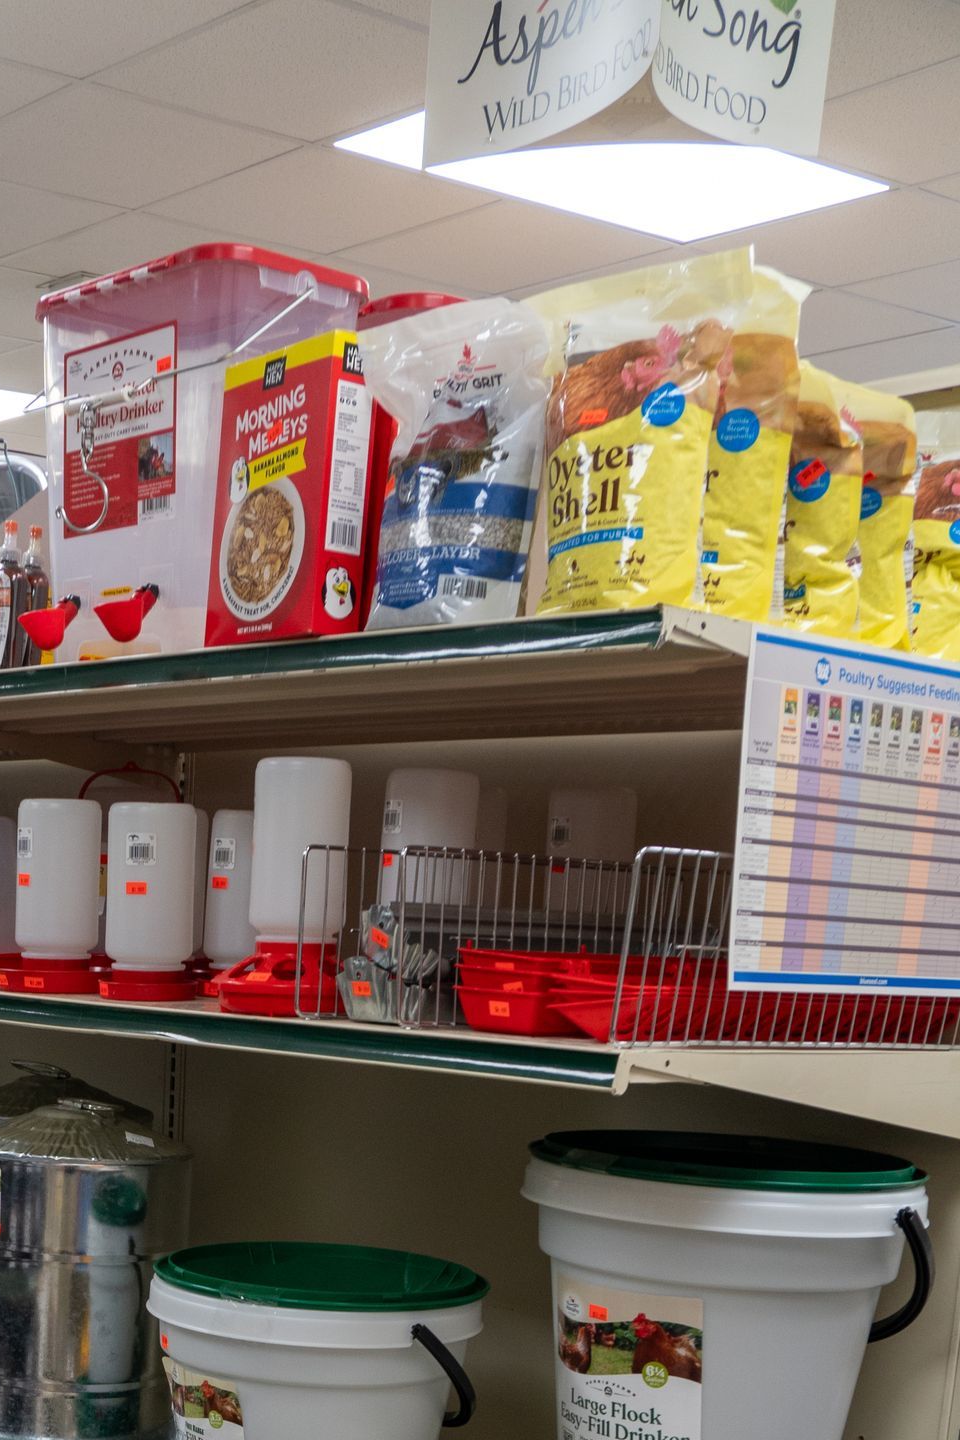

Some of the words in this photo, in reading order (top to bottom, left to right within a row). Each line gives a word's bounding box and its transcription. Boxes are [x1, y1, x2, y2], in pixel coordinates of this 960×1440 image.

[702, 0, 803, 89] Song
[704, 74, 768, 127] FOOD
[266, 368, 283, 388] HEN
[472, 372, 504, 390] GRIT
[120, 399, 165, 423] Drinker
[235, 383, 306, 441] MORNING
[253, 456, 275, 475] BANANA
[275, 446, 299, 464] ALMOND
[265, 462, 286, 478] FLAVOR
[548, 443, 637, 492] Oyster
[552, 476, 621, 528] Shell
[582, 532, 601, 545] FOR
[431, 546, 481, 561] LAYER
[243, 606, 259, 615] TREAT
[839, 667, 875, 691] Poultry
[876, 674, 927, 697] Suggested
[560, 1400, 611, 1438] Easy-Fill
[570, 1387, 607, 1416] Large
[611, 1401, 662, 1426] Flock
